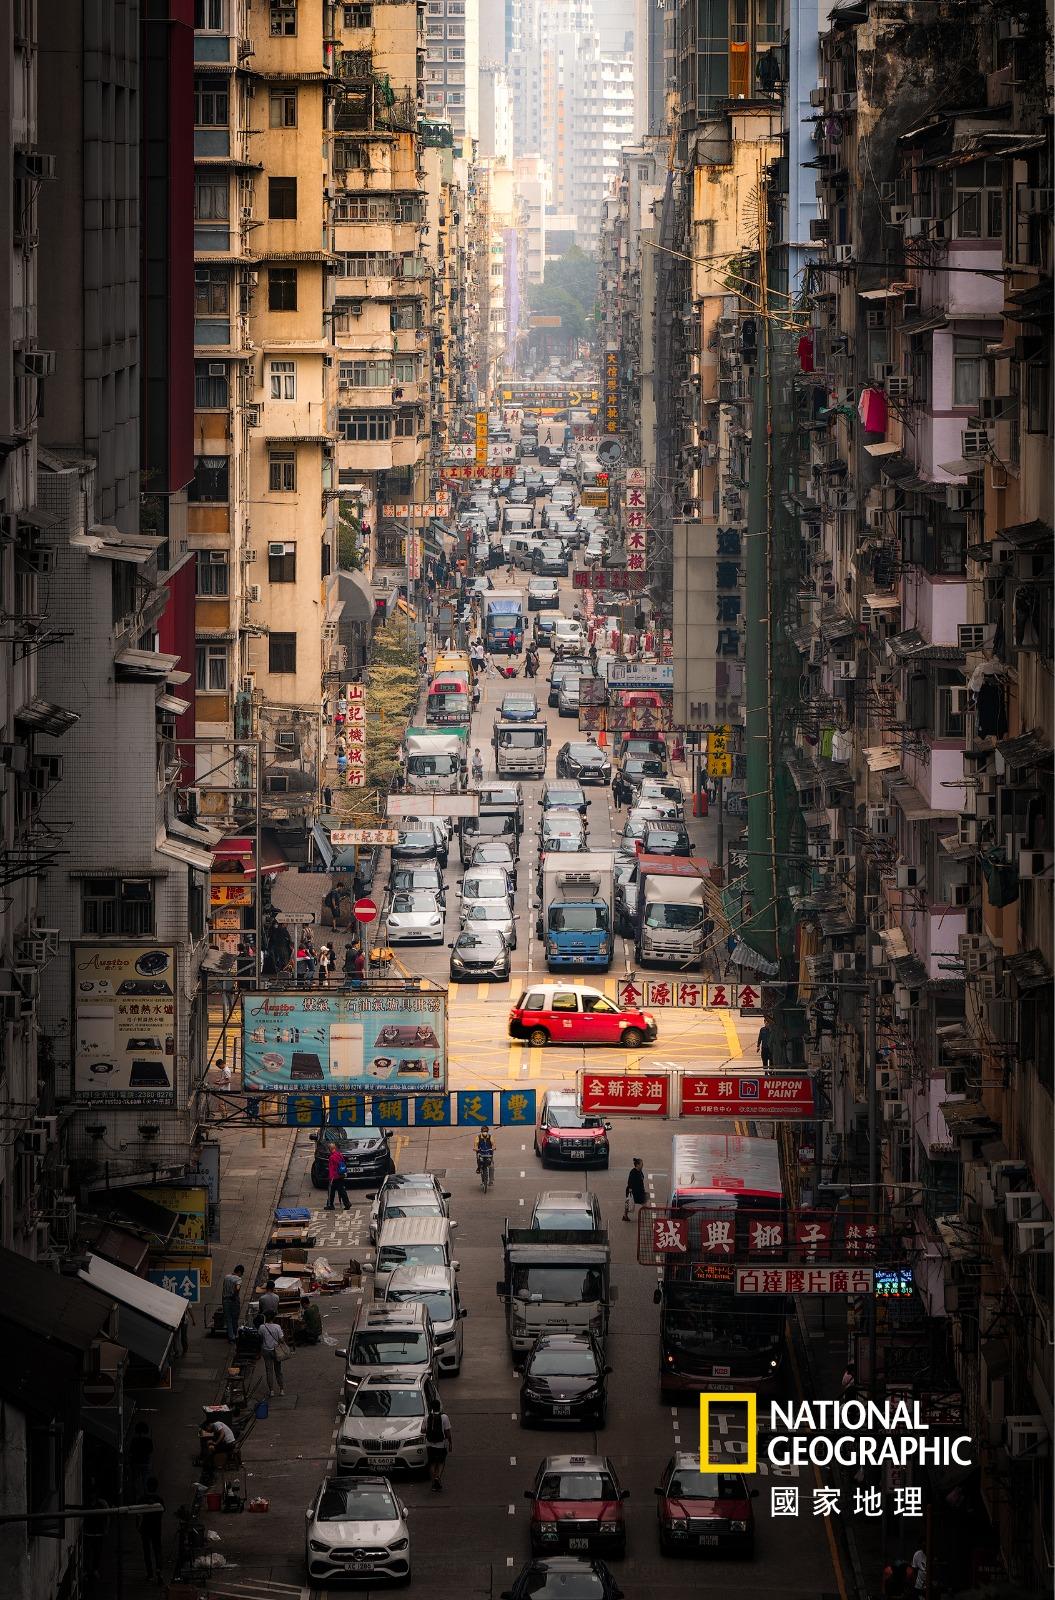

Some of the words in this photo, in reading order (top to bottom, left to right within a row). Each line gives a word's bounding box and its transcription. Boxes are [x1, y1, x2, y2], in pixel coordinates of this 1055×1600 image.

[348, 685, 364, 786] 山記機械行
[619, 981, 760, 1008] 金源行五金
[588, 1079, 663, 1098] 全新漆油
[694, 1081, 733, 1096] 立邦
[763, 1080, 803, 1090] NIPPON
[766, 1089, 799, 1099] PAINT
[655, 1220, 827, 1259] 誠興椰子
[739, 1269, 869, 1293] 百達膠片廣告
